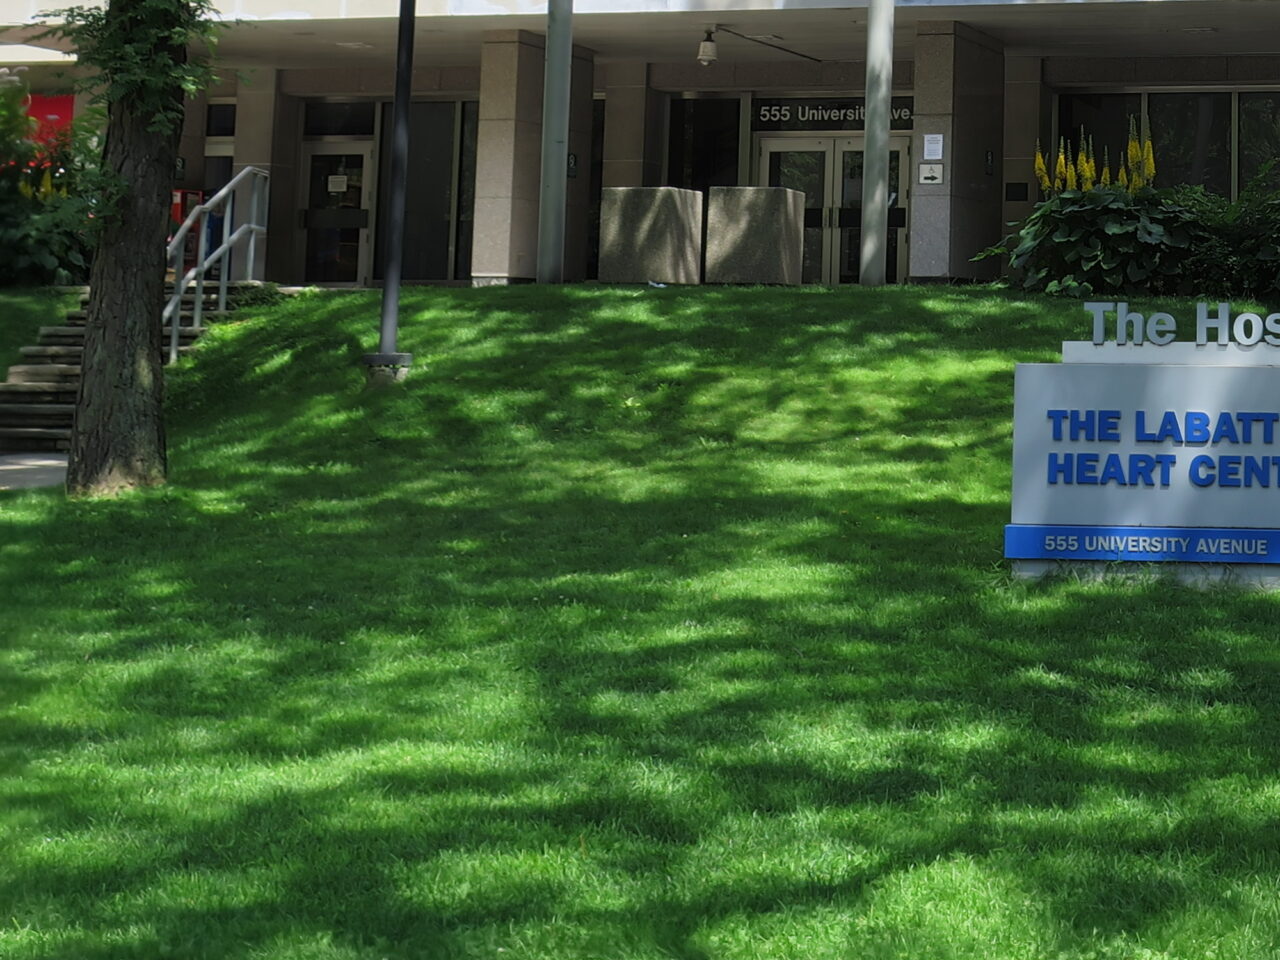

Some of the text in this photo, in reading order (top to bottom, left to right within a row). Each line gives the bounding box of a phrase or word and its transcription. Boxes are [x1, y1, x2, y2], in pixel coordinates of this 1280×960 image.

[759, 105, 915, 122] 555 Universit ve.
[1083, 301, 1177, 346] The
[1047, 409, 1121, 442] THE
[1135, 410, 1280, 444] LABATT
[1047, 452, 1176, 487] HEART
[1044, 535, 1268, 555] 555 UNIVERSITY AVENUE
